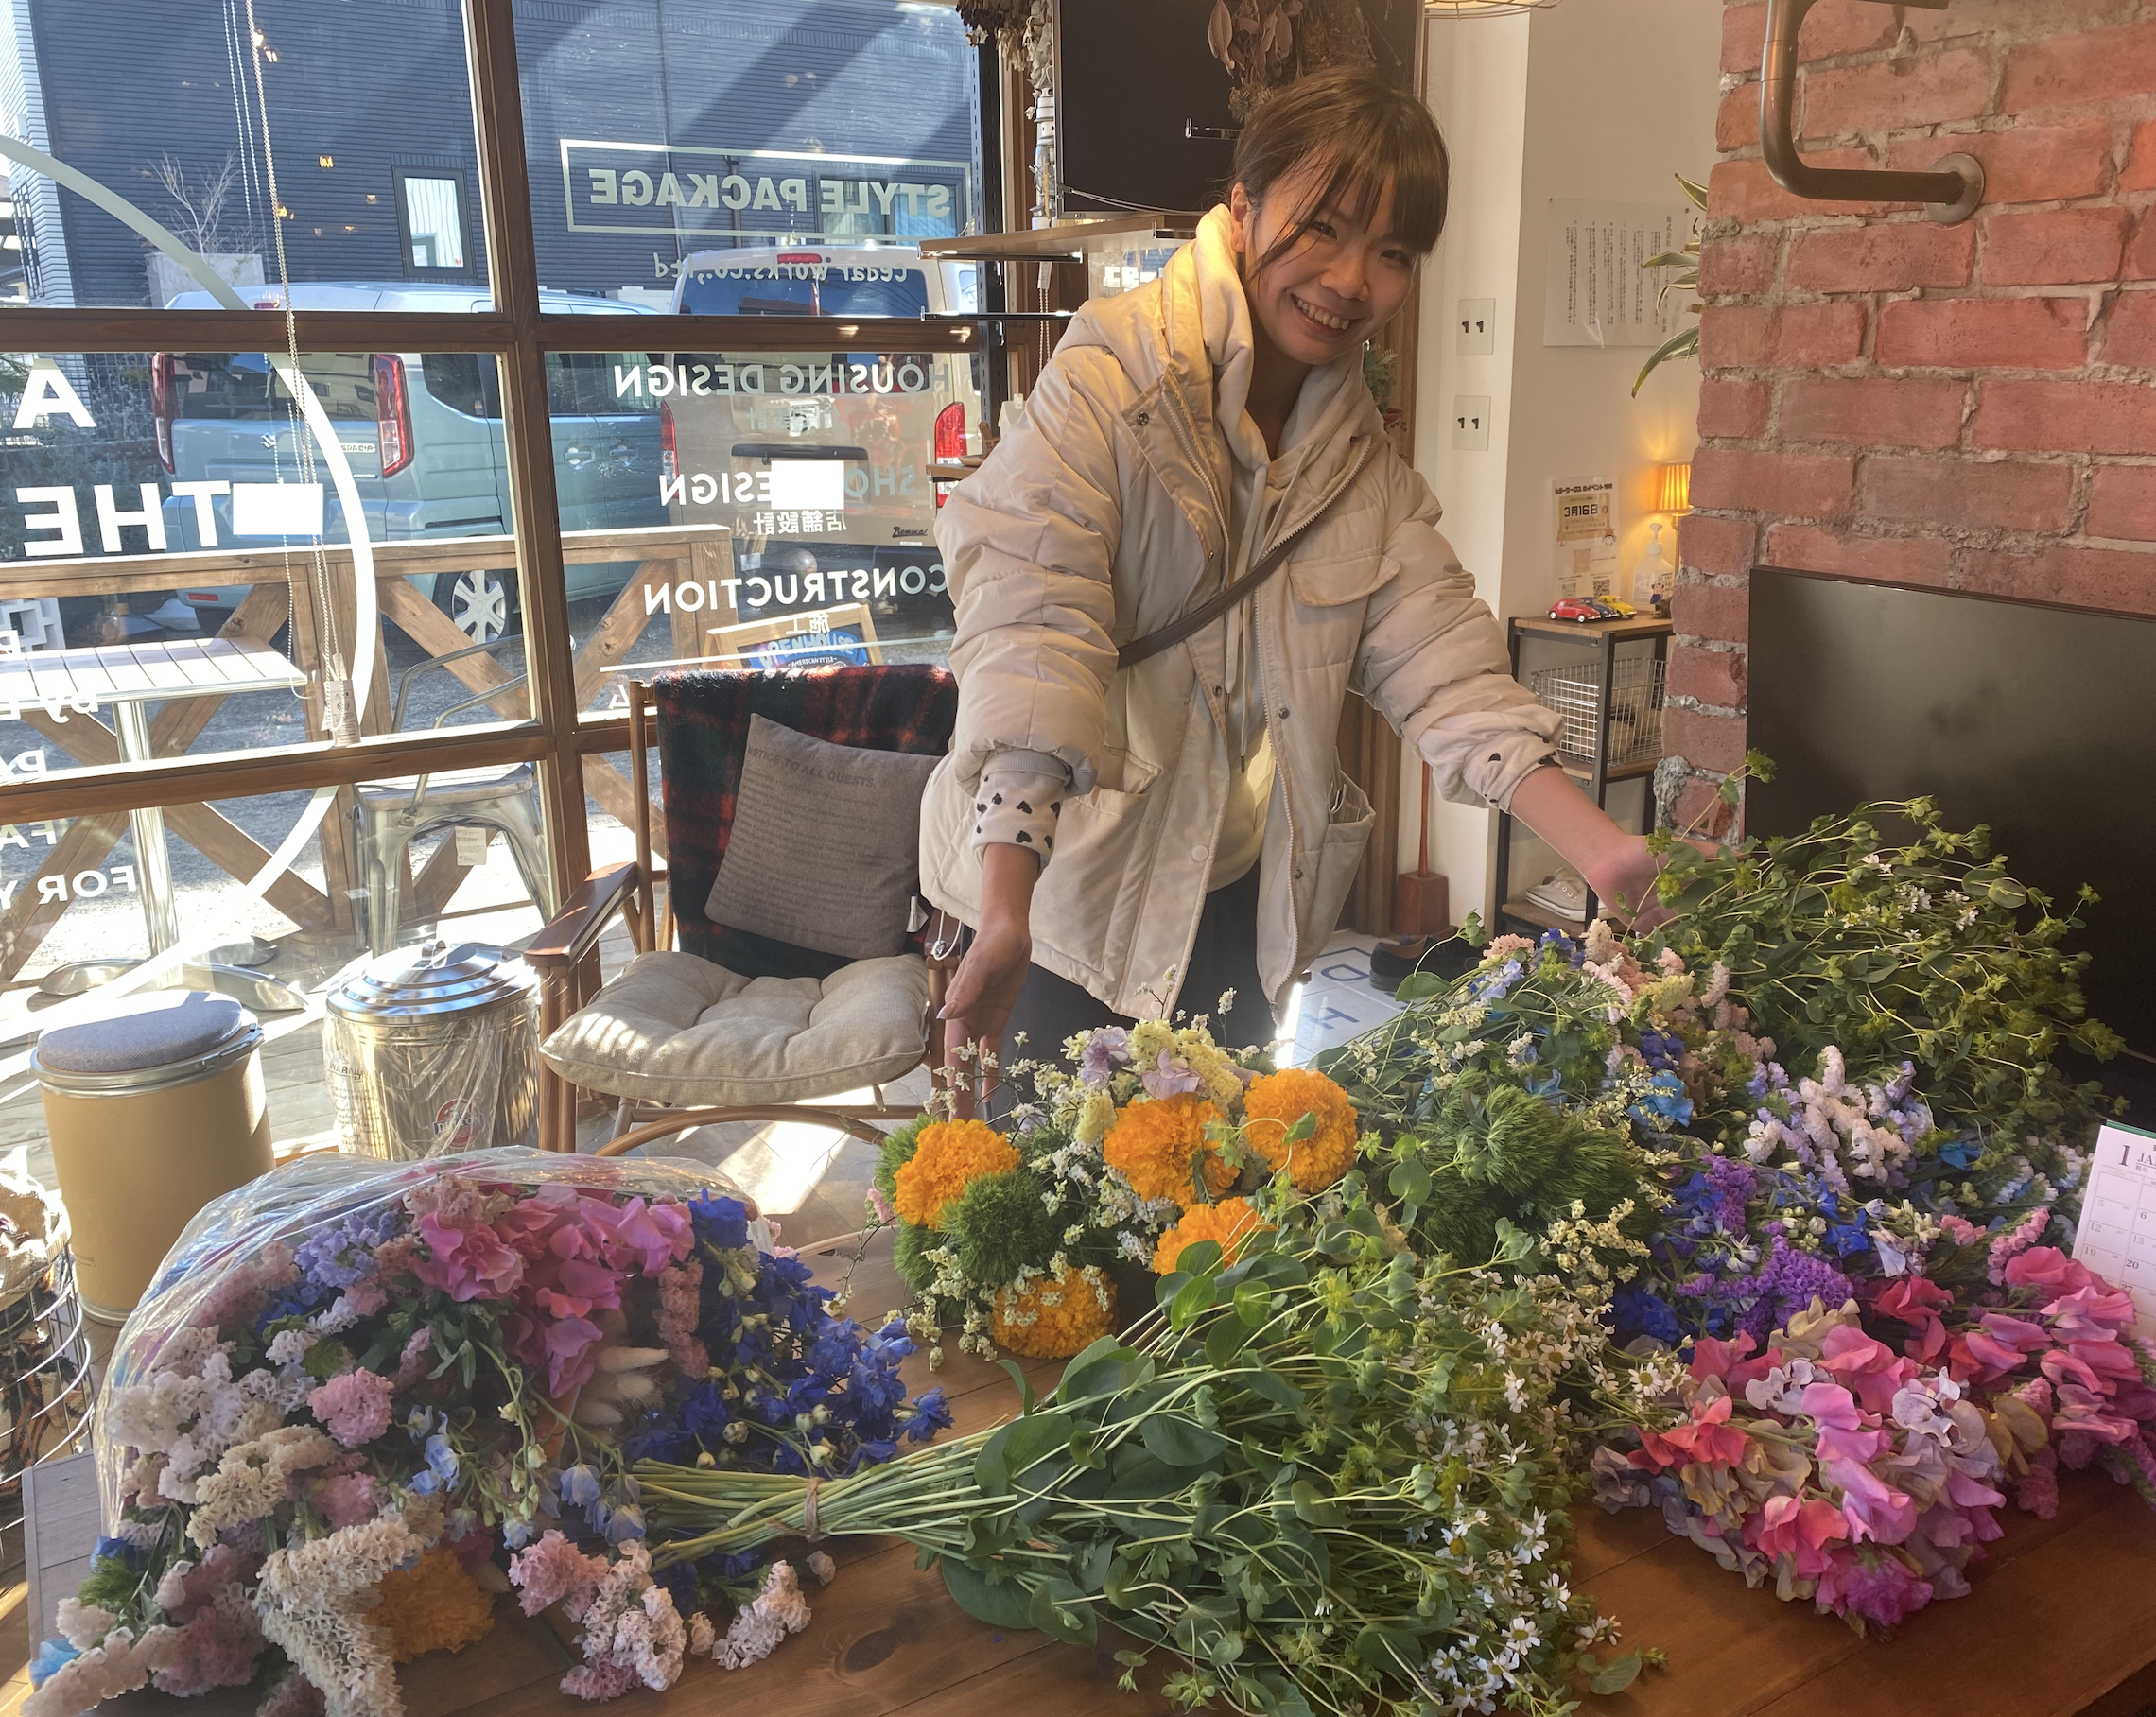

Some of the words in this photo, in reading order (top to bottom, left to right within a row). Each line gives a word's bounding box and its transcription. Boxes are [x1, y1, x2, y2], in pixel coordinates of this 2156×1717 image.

[1564, 504, 1598, 517] 3月16日
[748, 745, 781, 766] NOTICE
[784, 758, 800, 772] TO
[801, 766, 824, 779] ALL
[2118, 1144, 2130, 1168] 1
[2137, 1153, 2156, 1166] JA
[2097, 1199, 2105, 1208] 5
[2140, 1211, 2147, 1221] 6
[2090, 1223, 2102, 1233] 12
[2132, 1235, 2145, 1245] 13
[2084, 1246, 2096, 1257] 19
[2126, 1258, 2140, 1270] 20
